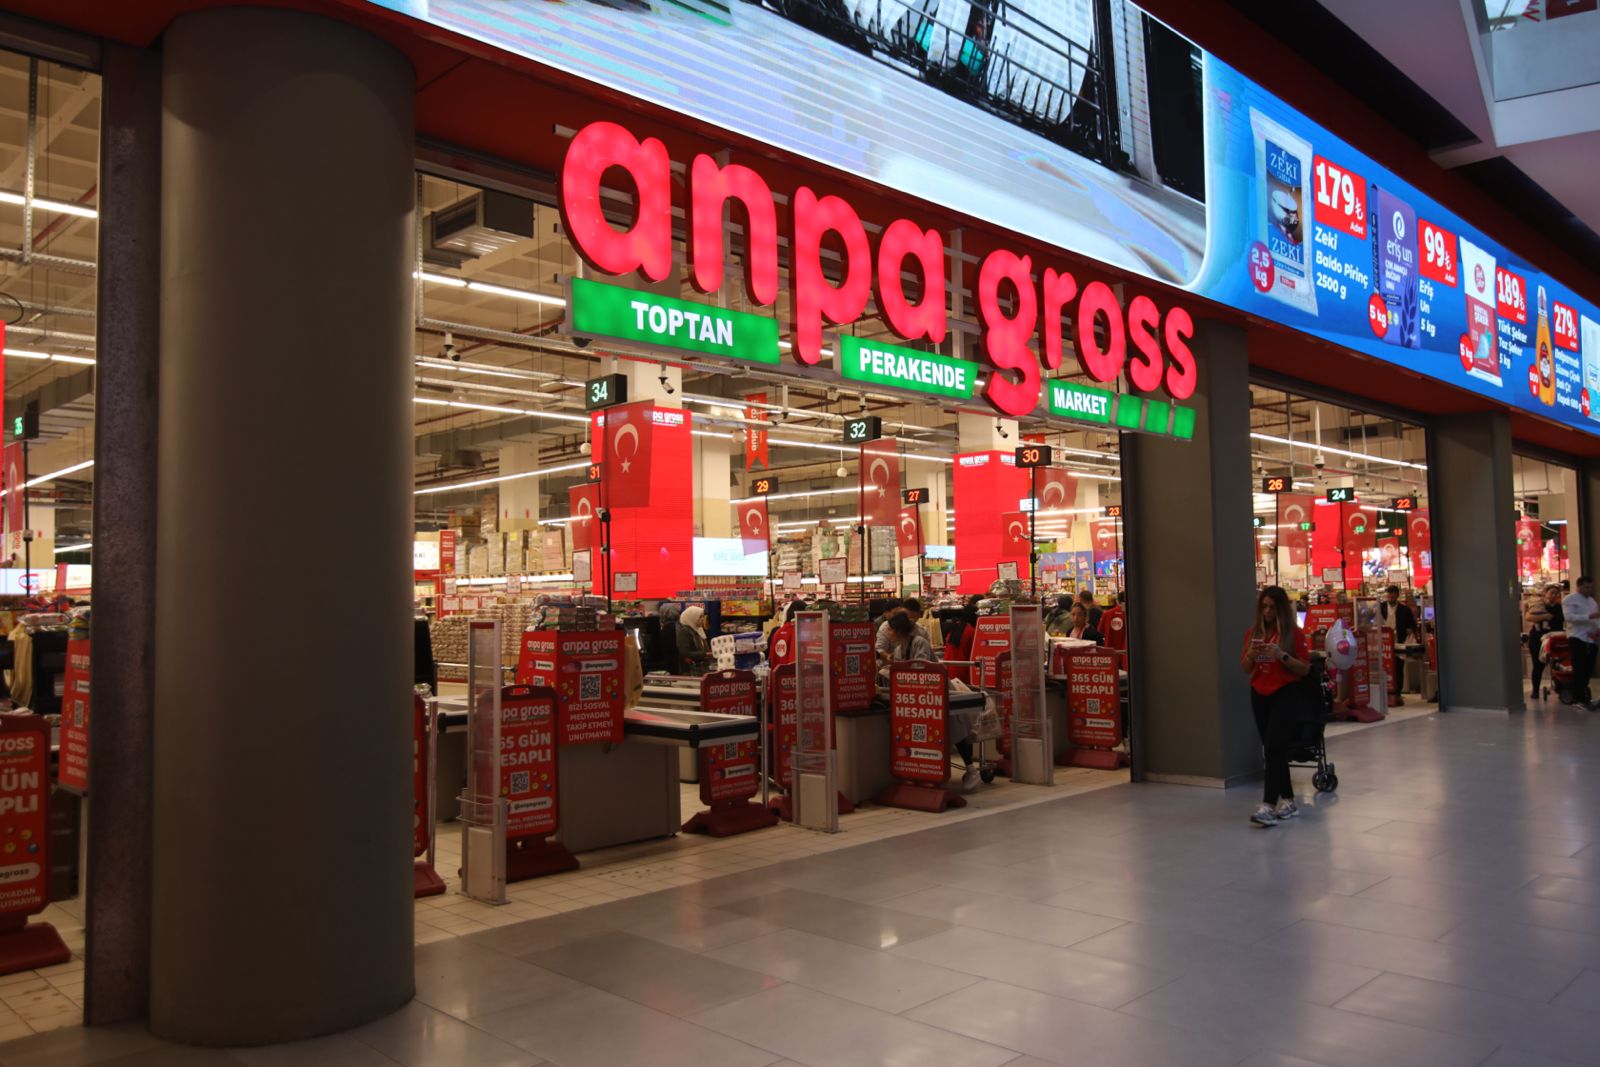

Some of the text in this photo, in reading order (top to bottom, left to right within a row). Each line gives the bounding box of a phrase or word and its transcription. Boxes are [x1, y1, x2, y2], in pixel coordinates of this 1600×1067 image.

[1315, 226, 1338, 250] Zeki
[1386, 240, 1412, 262] eriş un
[562, 121, 1197, 416] anpa gross
[1316, 250, 1342, 274] Baldo
[1344, 264, 1368, 290] Pirinç
[1254, 268, 1268, 288] kg
[1316, 272, 1339, 293] 2500
[1340, 286, 1347, 300] g
[1420, 280, 1434, 300] Eriş
[1420, 300, 1430, 314] Un
[631, 300, 733, 346] TOPTAN
[1370, 305, 1386, 328] 5 kg
[1421, 318, 1436, 338] 5 kg
[1498, 318, 1511, 336] Türk
[1460, 344, 1473, 364] 5 kg
[1499, 353, 1511, 370] 5 kg
[860, 347, 966, 390] PERAKENDE
[592, 381, 608, 402] 34
[1054, 387, 1108, 416] MARKET
[850, 422, 866, 438] 32
[1022, 448, 1039, 463] 30
[590, 466, 600, 480] 31
[756, 480, 769, 492] 29
[1268, 480, 1283, 490] 26
[908, 490, 919, 502] 27
[1332, 490, 1346, 500] 24
[1109, 507, 1120, 516] 23
[1397, 499, 1410, 508] 22
[528, 640, 540, 650] anpa
[563, 640, 618, 653] anpa gross
[896, 673, 940, 684] anpa gross
[1072, 672, 1114, 683] 365 GÜN
[710, 682, 750, 695] anpa gross
[1072, 686, 1114, 695] HESAPLI
[896, 692, 942, 706] 365 GÜN
[501, 704, 550, 721] pa gross
[896, 707, 942, 720] HESAPLI
[0, 737, 34, 751] ross
[500, 730, 551, 749] 65 GÜN
[500, 750, 551, 766] ESAPLI
[1, 768, 39, 791] ÜN
[0, 794, 39, 816] PLI
